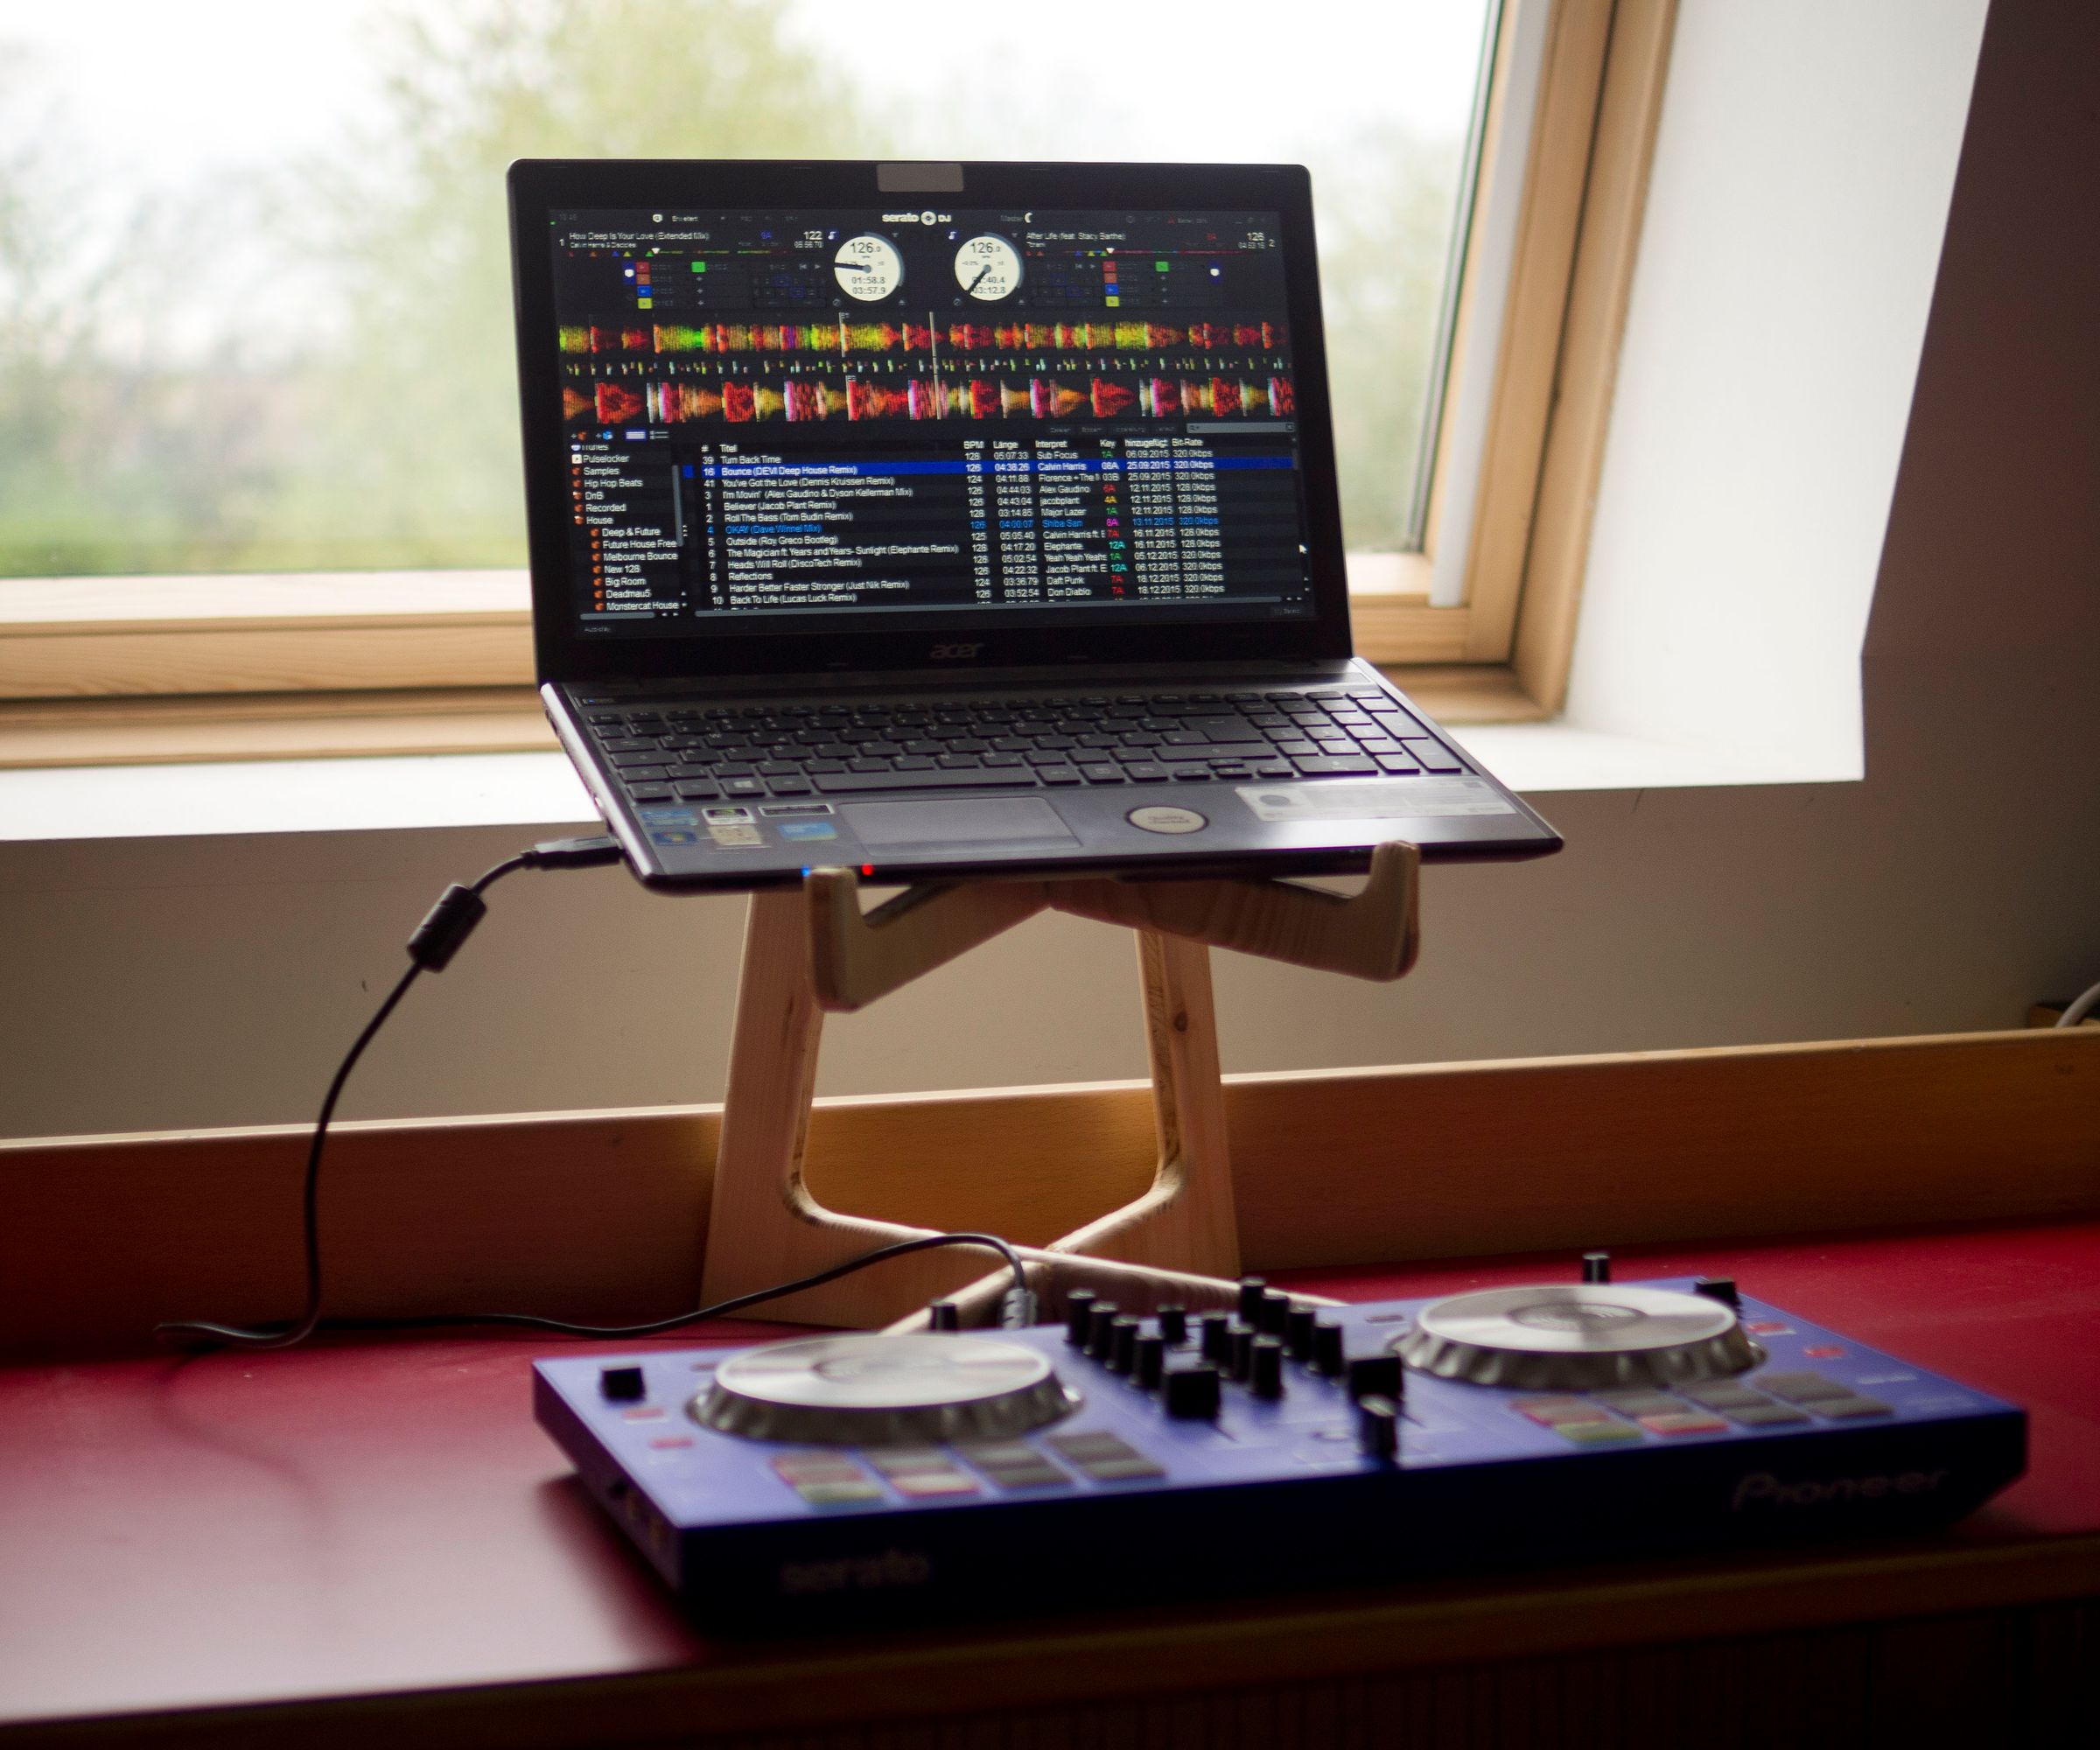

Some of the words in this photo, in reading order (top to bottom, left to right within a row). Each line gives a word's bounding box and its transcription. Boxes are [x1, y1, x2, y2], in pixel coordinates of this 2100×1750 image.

[882, 213, 919, 222] serato
[588, 233, 608, 242] Deep
[803, 231, 822, 240] 122
[1035, 440, 1068, 449] Interpret
[1099, 439, 1116, 449] Key
[761, 455, 781, 464] Time
[584, 467, 620, 476] Samples
[721, 467, 752, 476] Bounce
[778, 466, 801, 476] Deep
[829, 466, 858, 475] Remix)
[600, 480, 618, 488] Hop
[866, 477, 895, 486] Remix)
[765, 491, 785, 500] (Alex
[829, 489, 854, 499] Dyson
[895, 488, 913, 497] Mix)
[724, 502, 757, 511] Believer
[758, 502, 785, 512] (Jacob
[808, 501, 836, 510] Remix)
[1040, 497, 1080, 507] jacobplant
[780, 513, 800, 522] (Tom
[824, 512, 853, 522] Remix)
[1041, 508, 1064, 517] Major
[602, 528, 625, 537] Deep
[725, 525, 749, 534] OKAY
[751, 525, 776, 535] (Dave
[804, 524, 822, 534] Mix)
[804, 536, 838, 545] Bootleg)
[744, 549, 780, 558] Magician
[856, 546, 886, 556] Sunlight
[930, 545, 959, 555] Remix)
[833, 559, 862, 568] Remix)
[606, 578, 620, 587] Big
[811, 583, 845, 592] Stronger
[881, 581, 910, 590] Remix)
[606, 590, 652, 598] Deadmau5
[780, 595, 807, 604] (Lucas
[828, 593, 857, 603] Remix)
[606, 602, 651, 611] Monstercat
[1731, 1466, 1950, 1511] Pioneer
